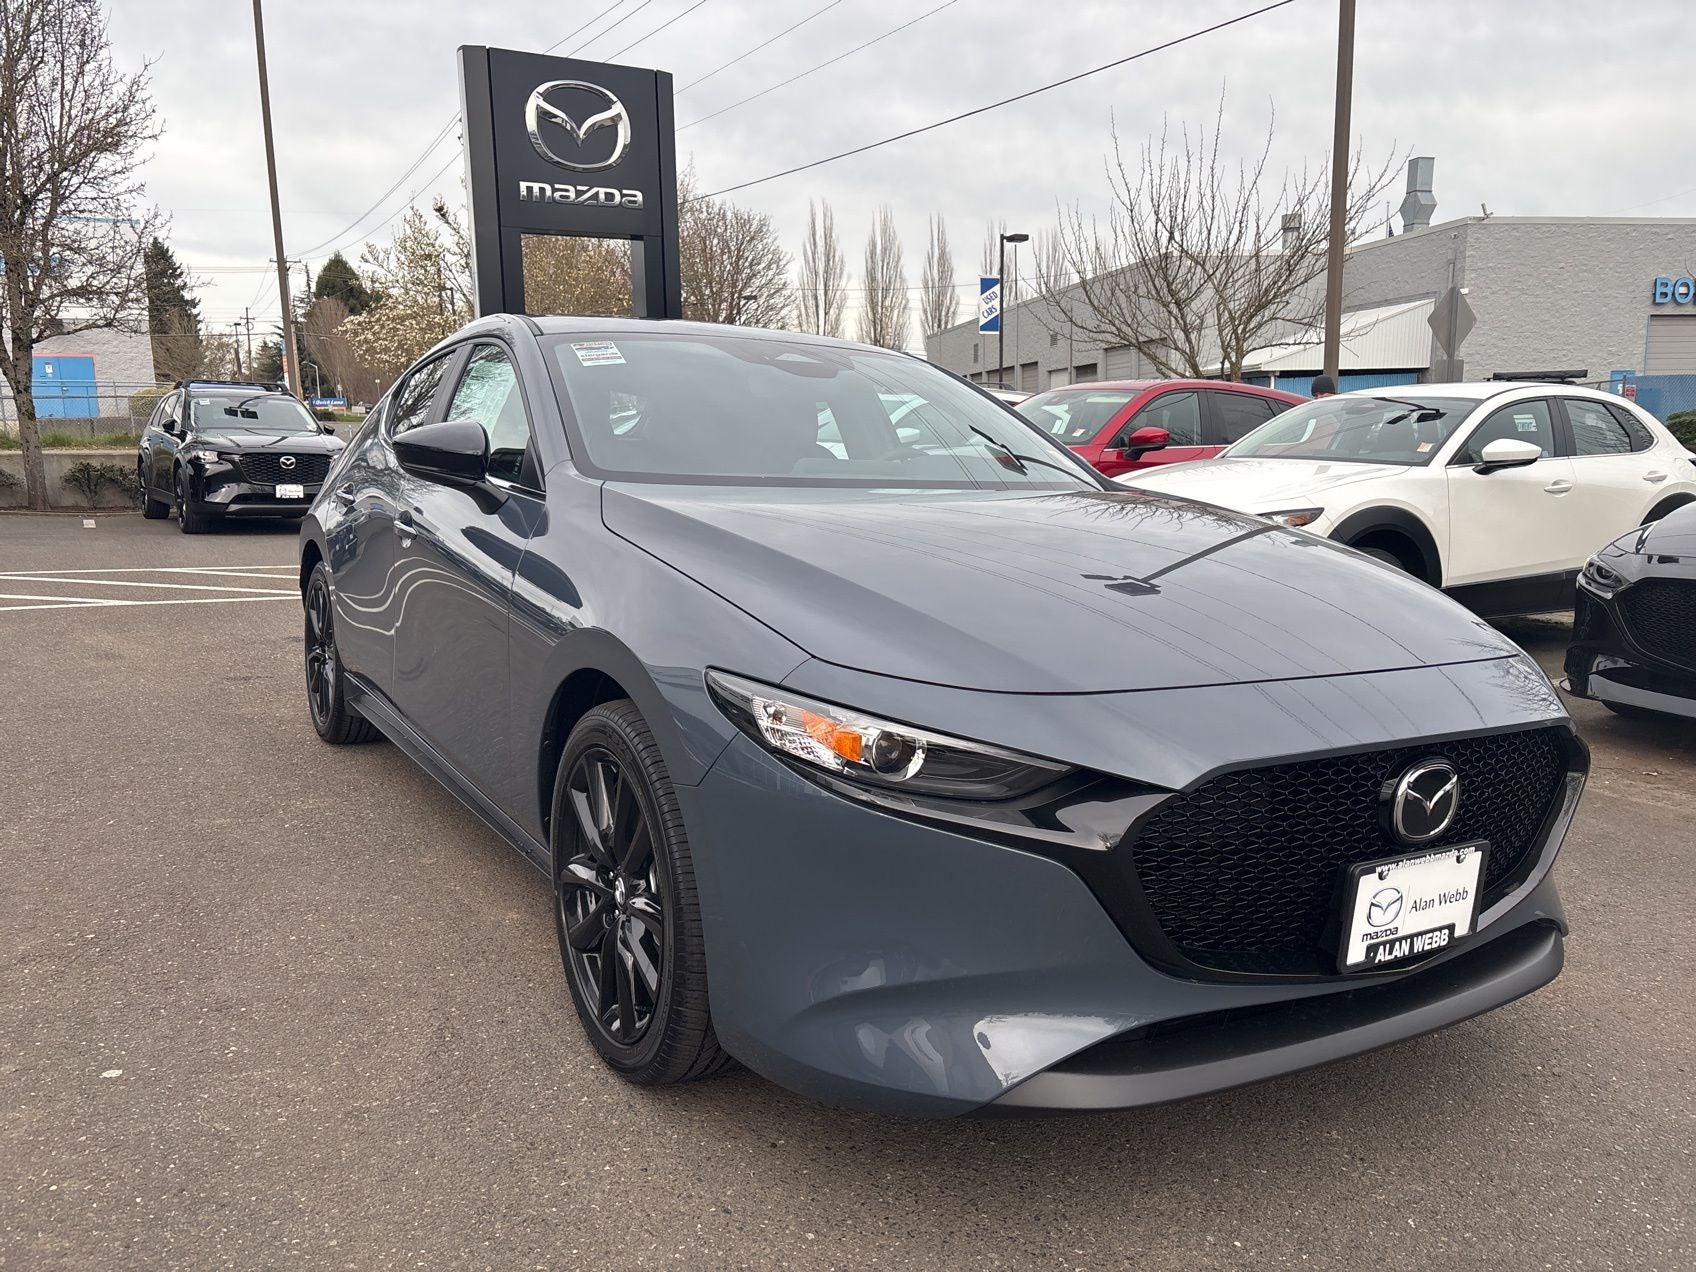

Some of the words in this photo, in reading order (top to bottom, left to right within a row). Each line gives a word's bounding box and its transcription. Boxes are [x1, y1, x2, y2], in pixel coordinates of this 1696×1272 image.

[982, 291, 998, 305] USED
[1652, 276, 1696, 306] BO
[981, 305, 997, 319] CARS
[1409, 896, 1435, 914] Alan
[1438, 886, 1468, 907] Webb
[1361, 926, 1399, 943] mazda
[1375, 939, 1410, 963] ALAN
[1413, 929, 1449, 954] WEBB
